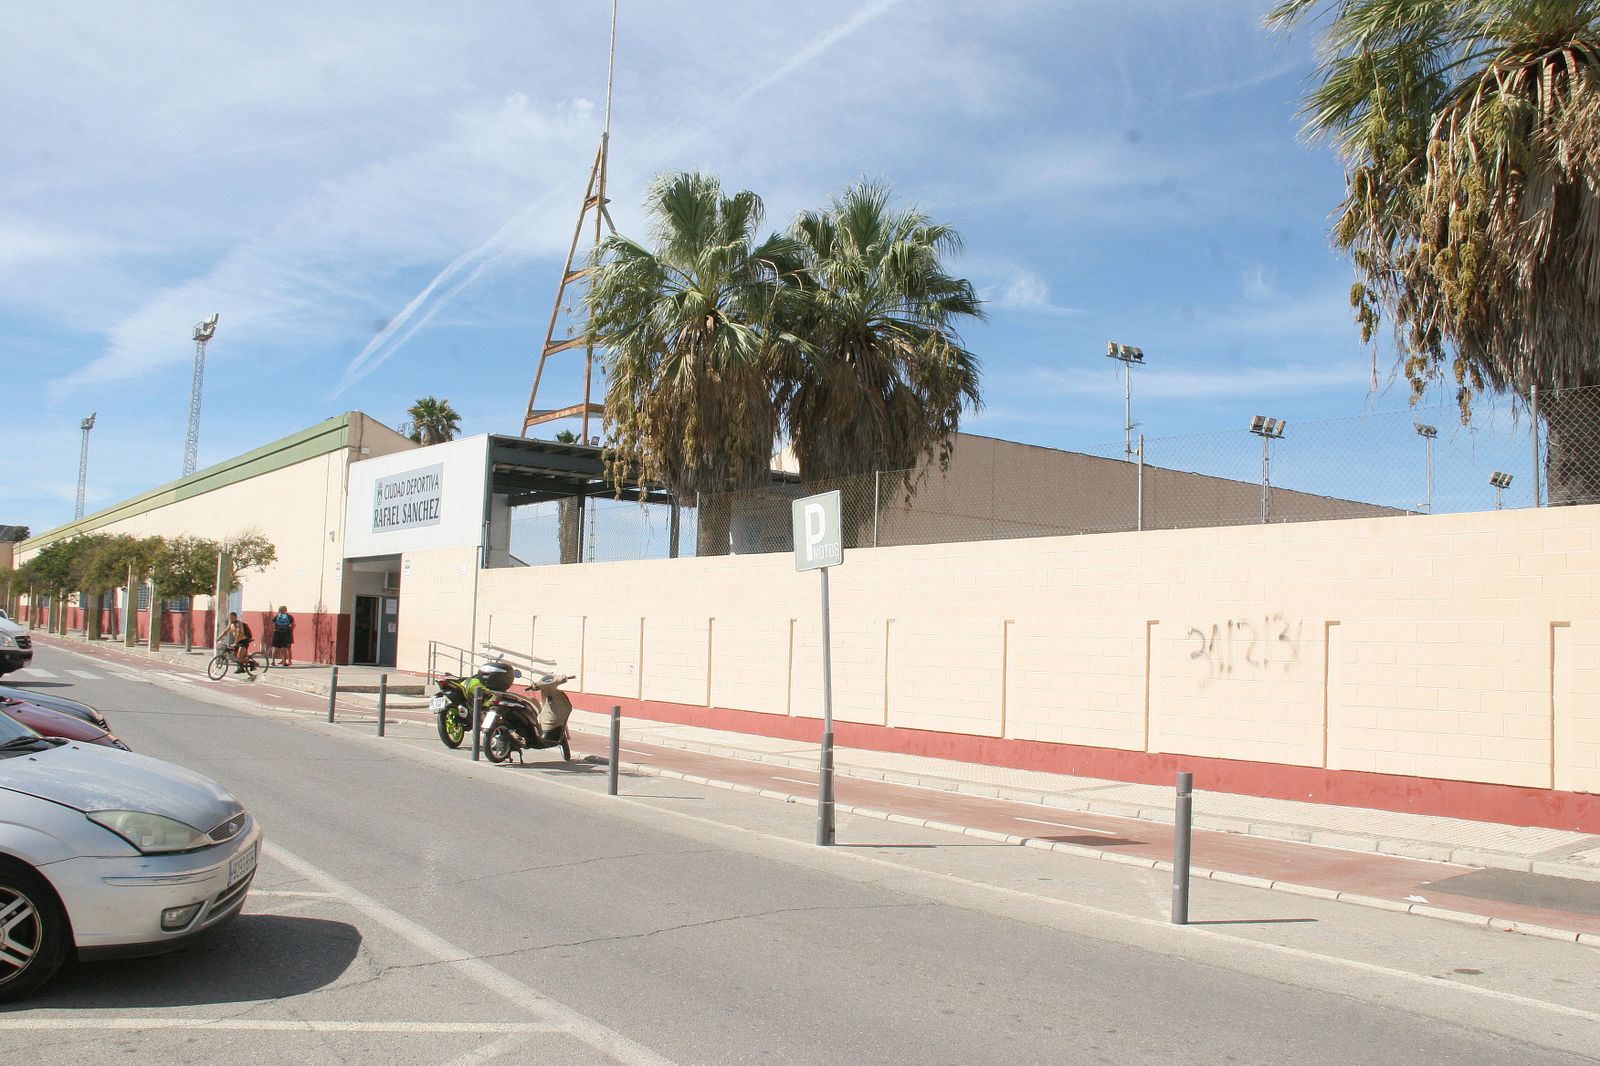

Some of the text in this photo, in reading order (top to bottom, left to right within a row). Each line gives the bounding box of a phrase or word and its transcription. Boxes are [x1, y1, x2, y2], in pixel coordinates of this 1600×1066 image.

[384, 474, 439, 500] CIUDAD DEPORTIVA
[374, 497, 440, 528] RAFAEL SÁNCHEZ
[805, 503, 826, 561] P
[813, 543, 840, 561] MOTOS
